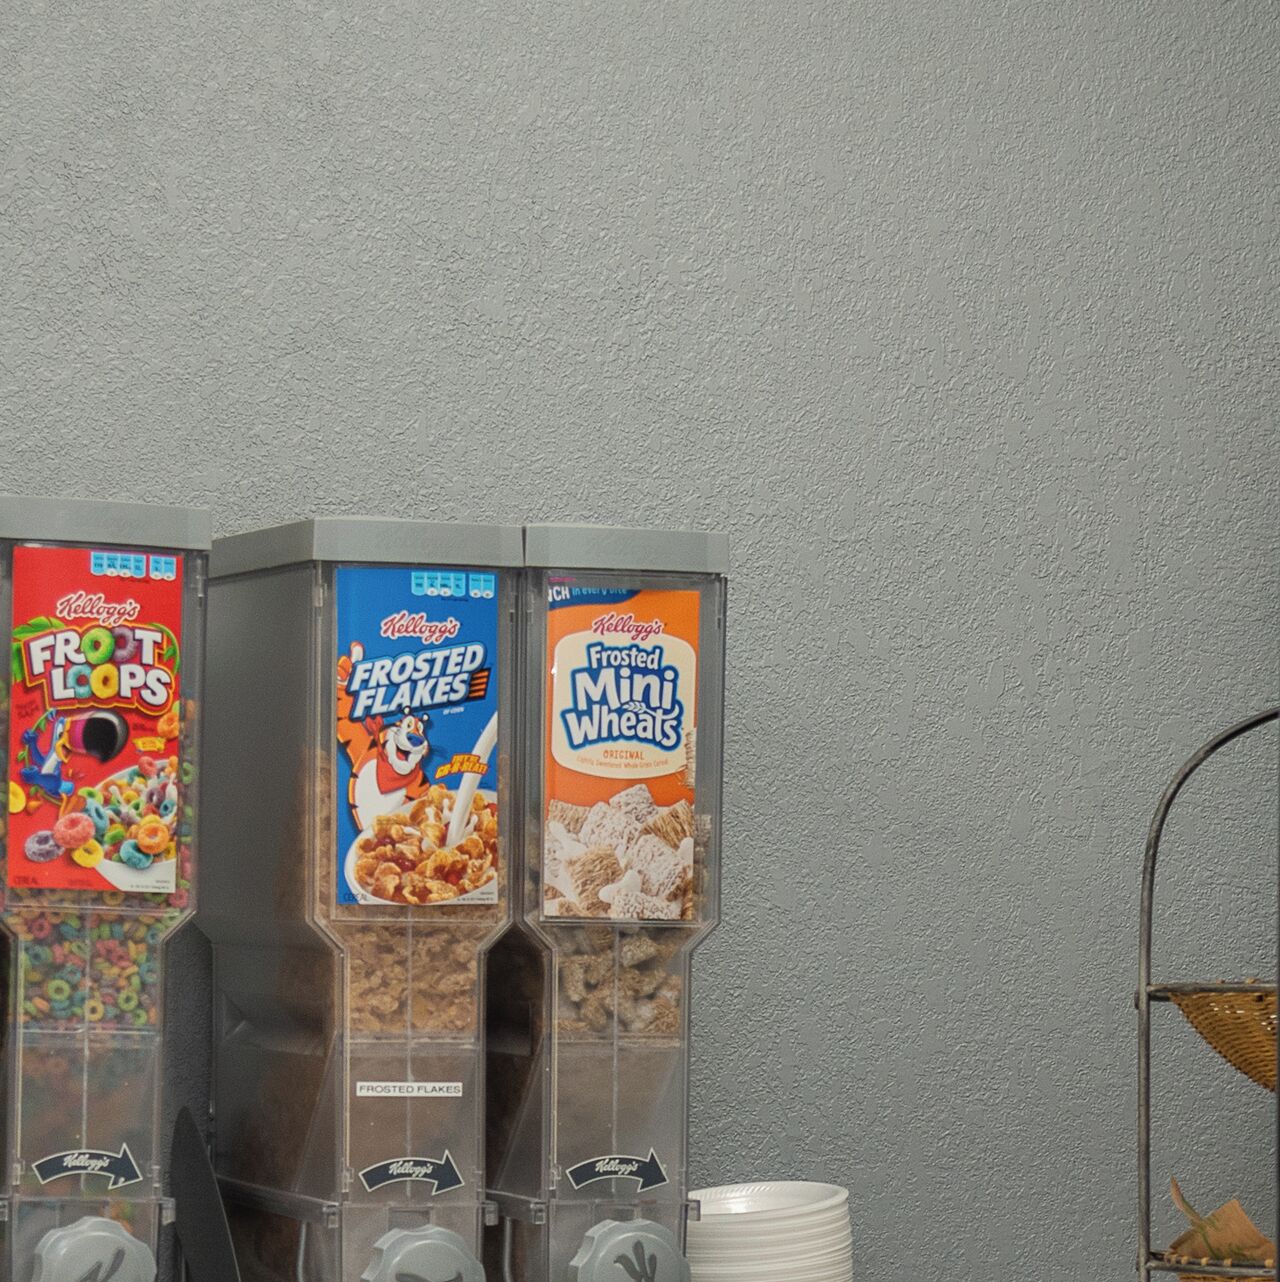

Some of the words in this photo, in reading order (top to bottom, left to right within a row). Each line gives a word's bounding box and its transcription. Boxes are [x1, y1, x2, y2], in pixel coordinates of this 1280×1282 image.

[56, 592, 140, 625] Kellogg's
[381, 611, 459, 644] Kellogg's
[592, 613, 663, 641] Kellogg's
[28, 626, 162, 676] FROOT
[589, 644, 660, 671] Frosted
[50, 663, 170, 706] LOOPS
[351, 645, 484, 692] FROSTED
[352, 672, 471, 719] FLAKES
[575, 666, 676, 713] Mini
[565, 704, 680, 748] Wheats
[602, 750, 645, 760] ORIGINAL
[359, 1084, 415, 1094] FROSTED
[417, 1084, 462, 1094] FLAKES
[63, 1153, 110, 1171] Kellogg's
[388, 1161, 433, 1179] Kellogg's
[595, 1158, 640, 1176] Kellogg's
